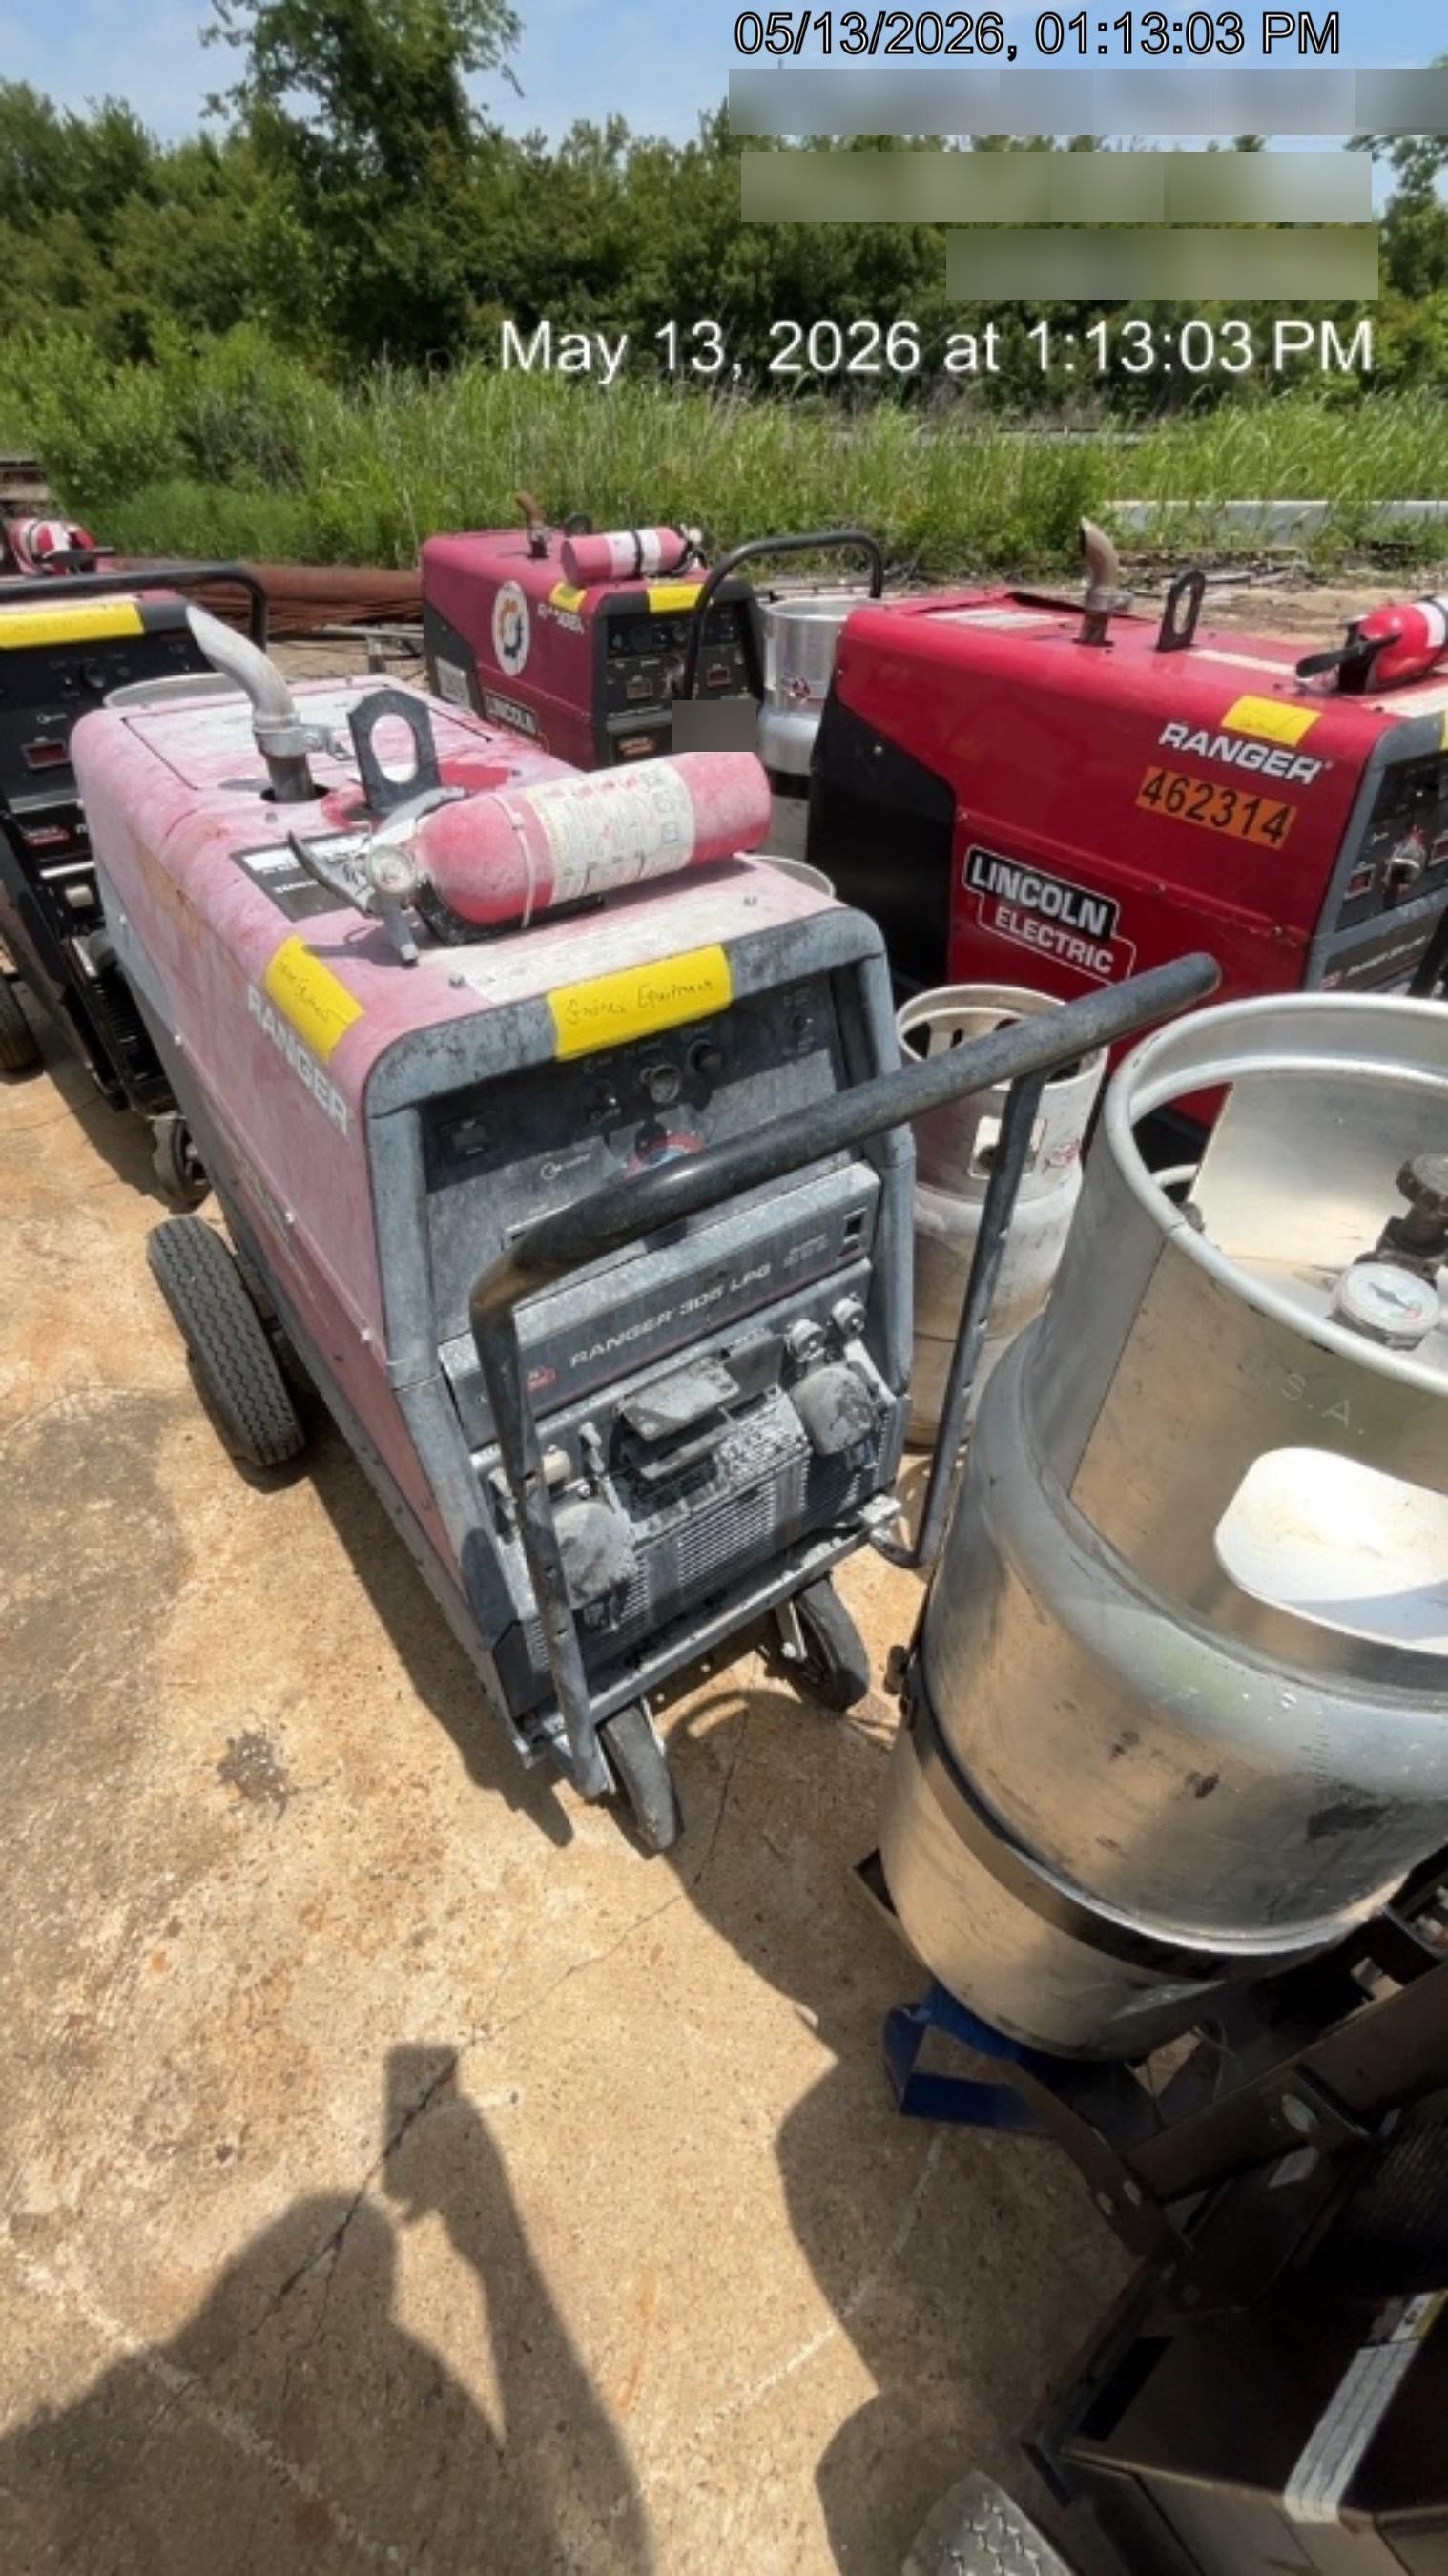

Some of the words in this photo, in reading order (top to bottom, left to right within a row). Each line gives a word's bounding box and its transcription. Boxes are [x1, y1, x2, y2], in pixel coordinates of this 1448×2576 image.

[1158, 722, 1324, 786] RANGER
[1141, 772, 1292, 845] 462314
[971, 855, 1109, 937] LINCOLN
[994, 905, 1115, 975] ELECTRIC
[247, 983, 347, 1137] RANGER
[570, 1309, 675, 1369] RANGER
[678, 1285, 725, 1316] 305
[729, 1262, 772, 1294] LPG
